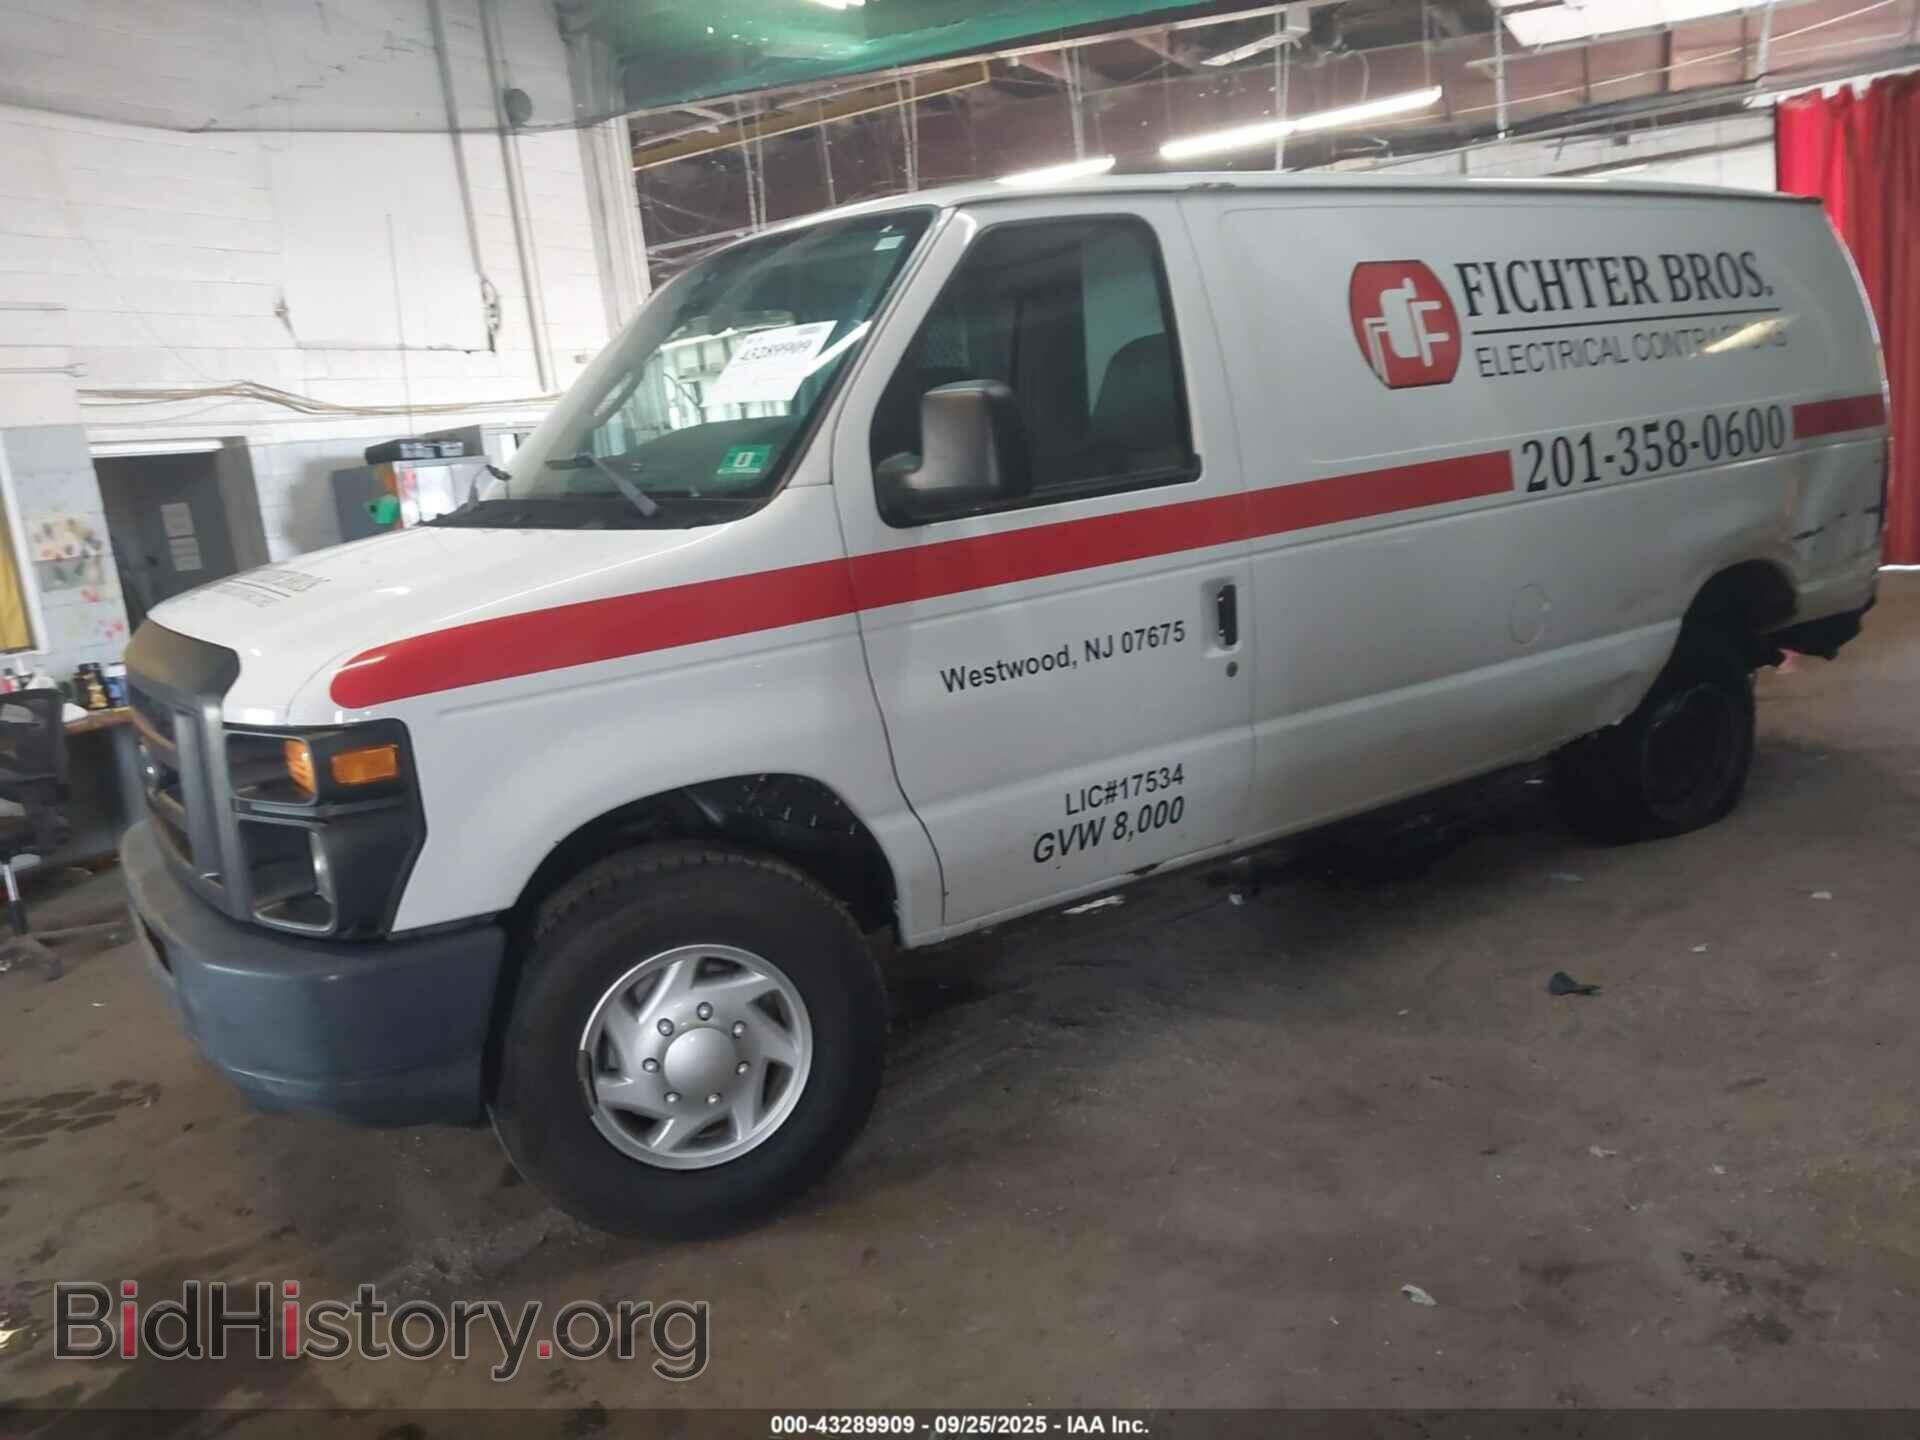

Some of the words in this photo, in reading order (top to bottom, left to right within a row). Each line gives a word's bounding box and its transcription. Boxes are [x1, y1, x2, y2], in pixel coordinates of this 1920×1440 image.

[1454, 254, 1658, 317] FICHTER
[1658, 251, 1774, 306] BROS.
[1476, 335, 1629, 378] ELECTRICAL
[1632, 320, 1787, 361] CONTRAS
[1522, 404, 1785, 493] 201-358-0600
[940, 644, 1078, 693] Westwood,
[1084, 635, 1115, 663] NJ
[1121, 620, 1185, 655] 07675
[1065, 763, 1184, 816] LIC#17534
[1033, 816, 1106, 863] GVW
[1112, 795, 1185, 843] 8,000
